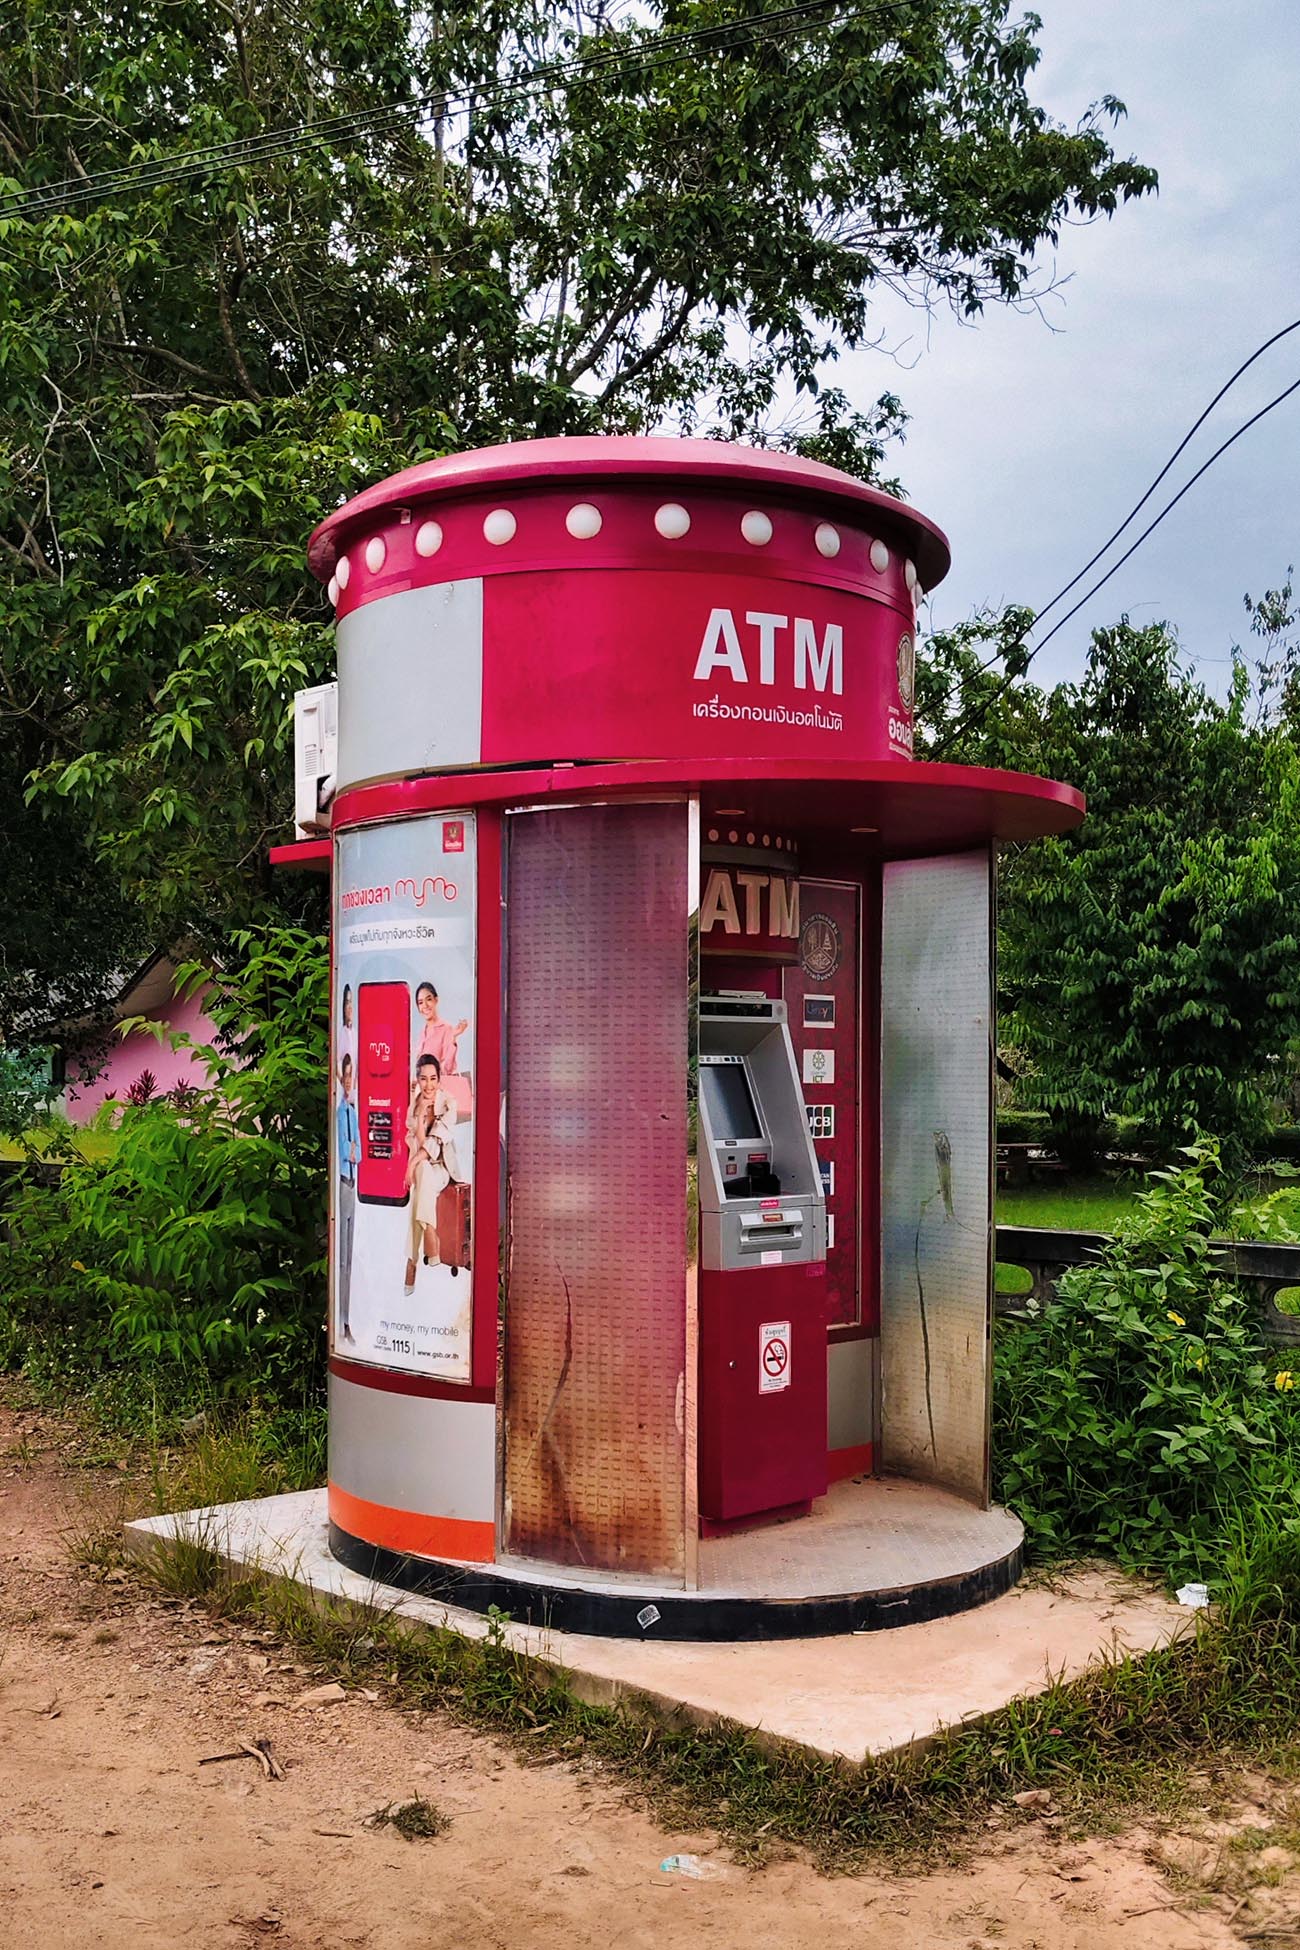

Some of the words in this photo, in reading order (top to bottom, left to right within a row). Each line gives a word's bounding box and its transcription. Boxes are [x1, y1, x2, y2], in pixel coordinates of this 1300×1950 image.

[693, 608, 844, 696] ATM
[700, 869, 800, 939] ATM
[808, 1115, 832, 1128] JCB
[379, 1320, 389, 1331] my
[417, 1325, 430, 1336] my
[431, 1326, 459, 1337] mobile
[392, 1339, 411, 1354] 1115
